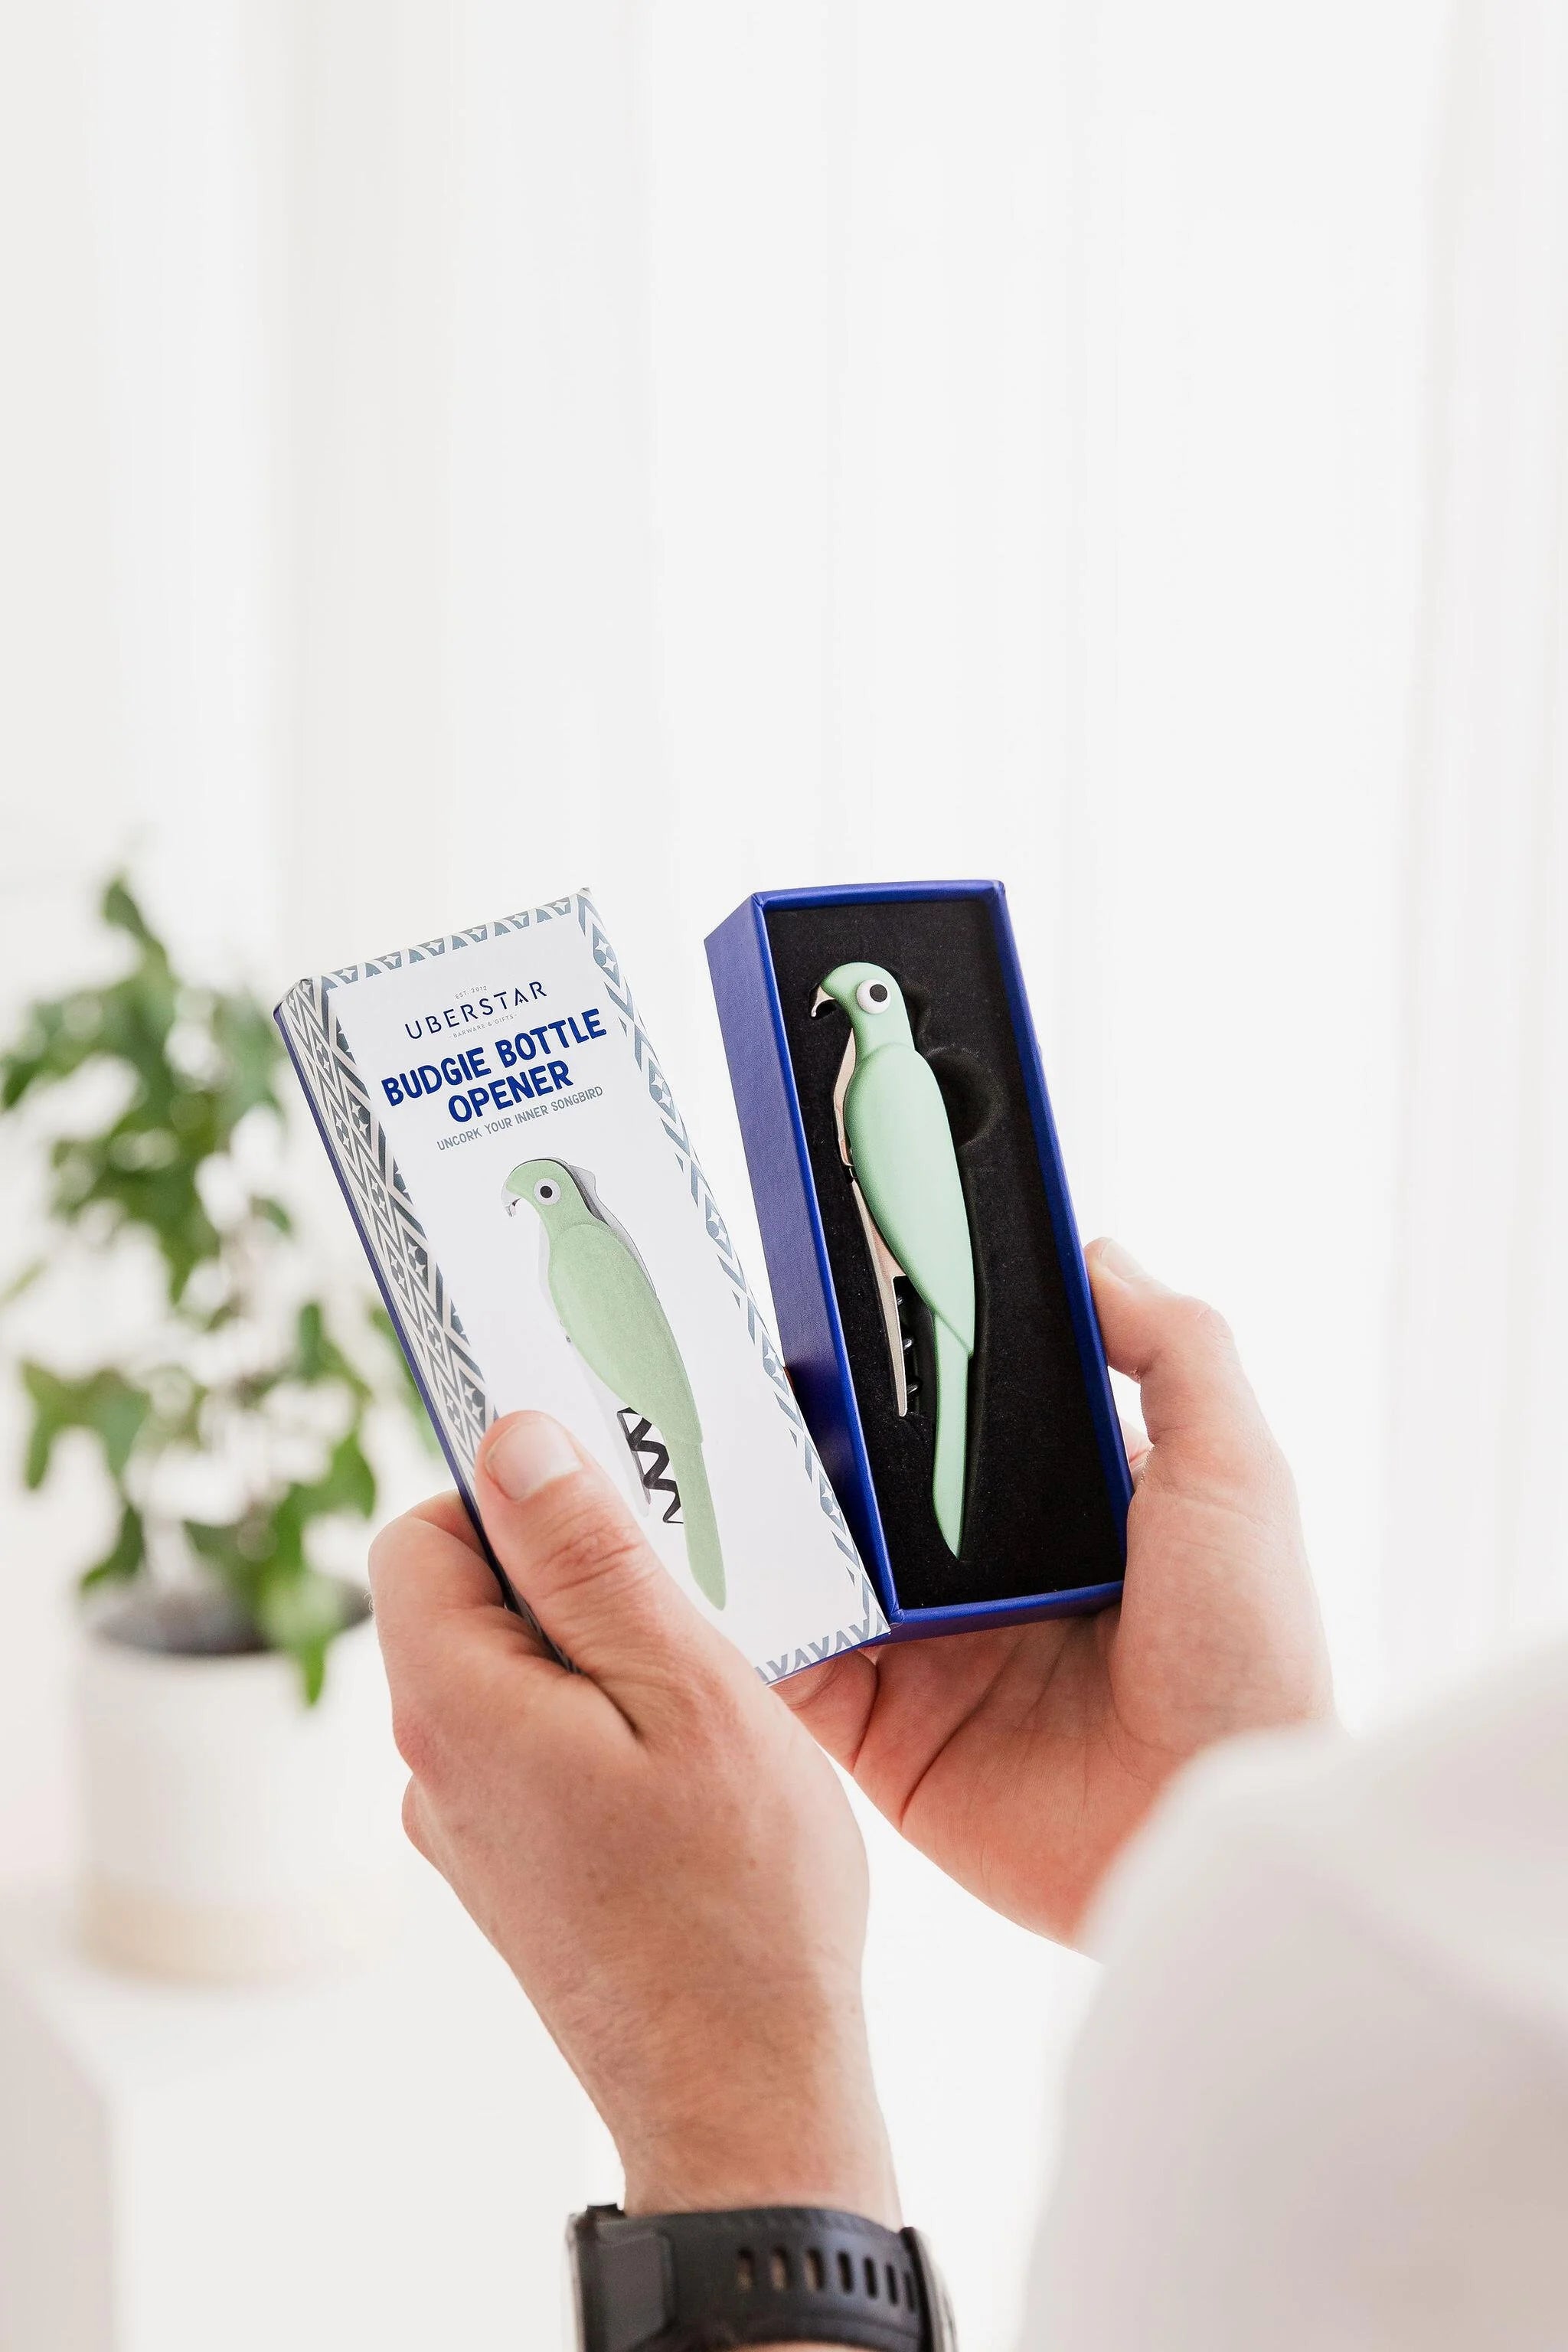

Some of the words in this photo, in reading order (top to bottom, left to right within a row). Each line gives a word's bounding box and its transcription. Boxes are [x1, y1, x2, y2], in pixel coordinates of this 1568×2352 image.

[405, 981, 547, 1039] UBERSTAR
[381, 1047, 491, 1106] BUDGIE
[495, 1008, 606, 1067] BOTTLE
[437, 1129, 482, 1151] UNCORK
[484, 1118, 513, 1135] YOUR
[515, 1105, 549, 1124] INNER
[551, 1086, 603, 1111] SONGBIRD
[448, 1060, 573, 1122] OPENER
